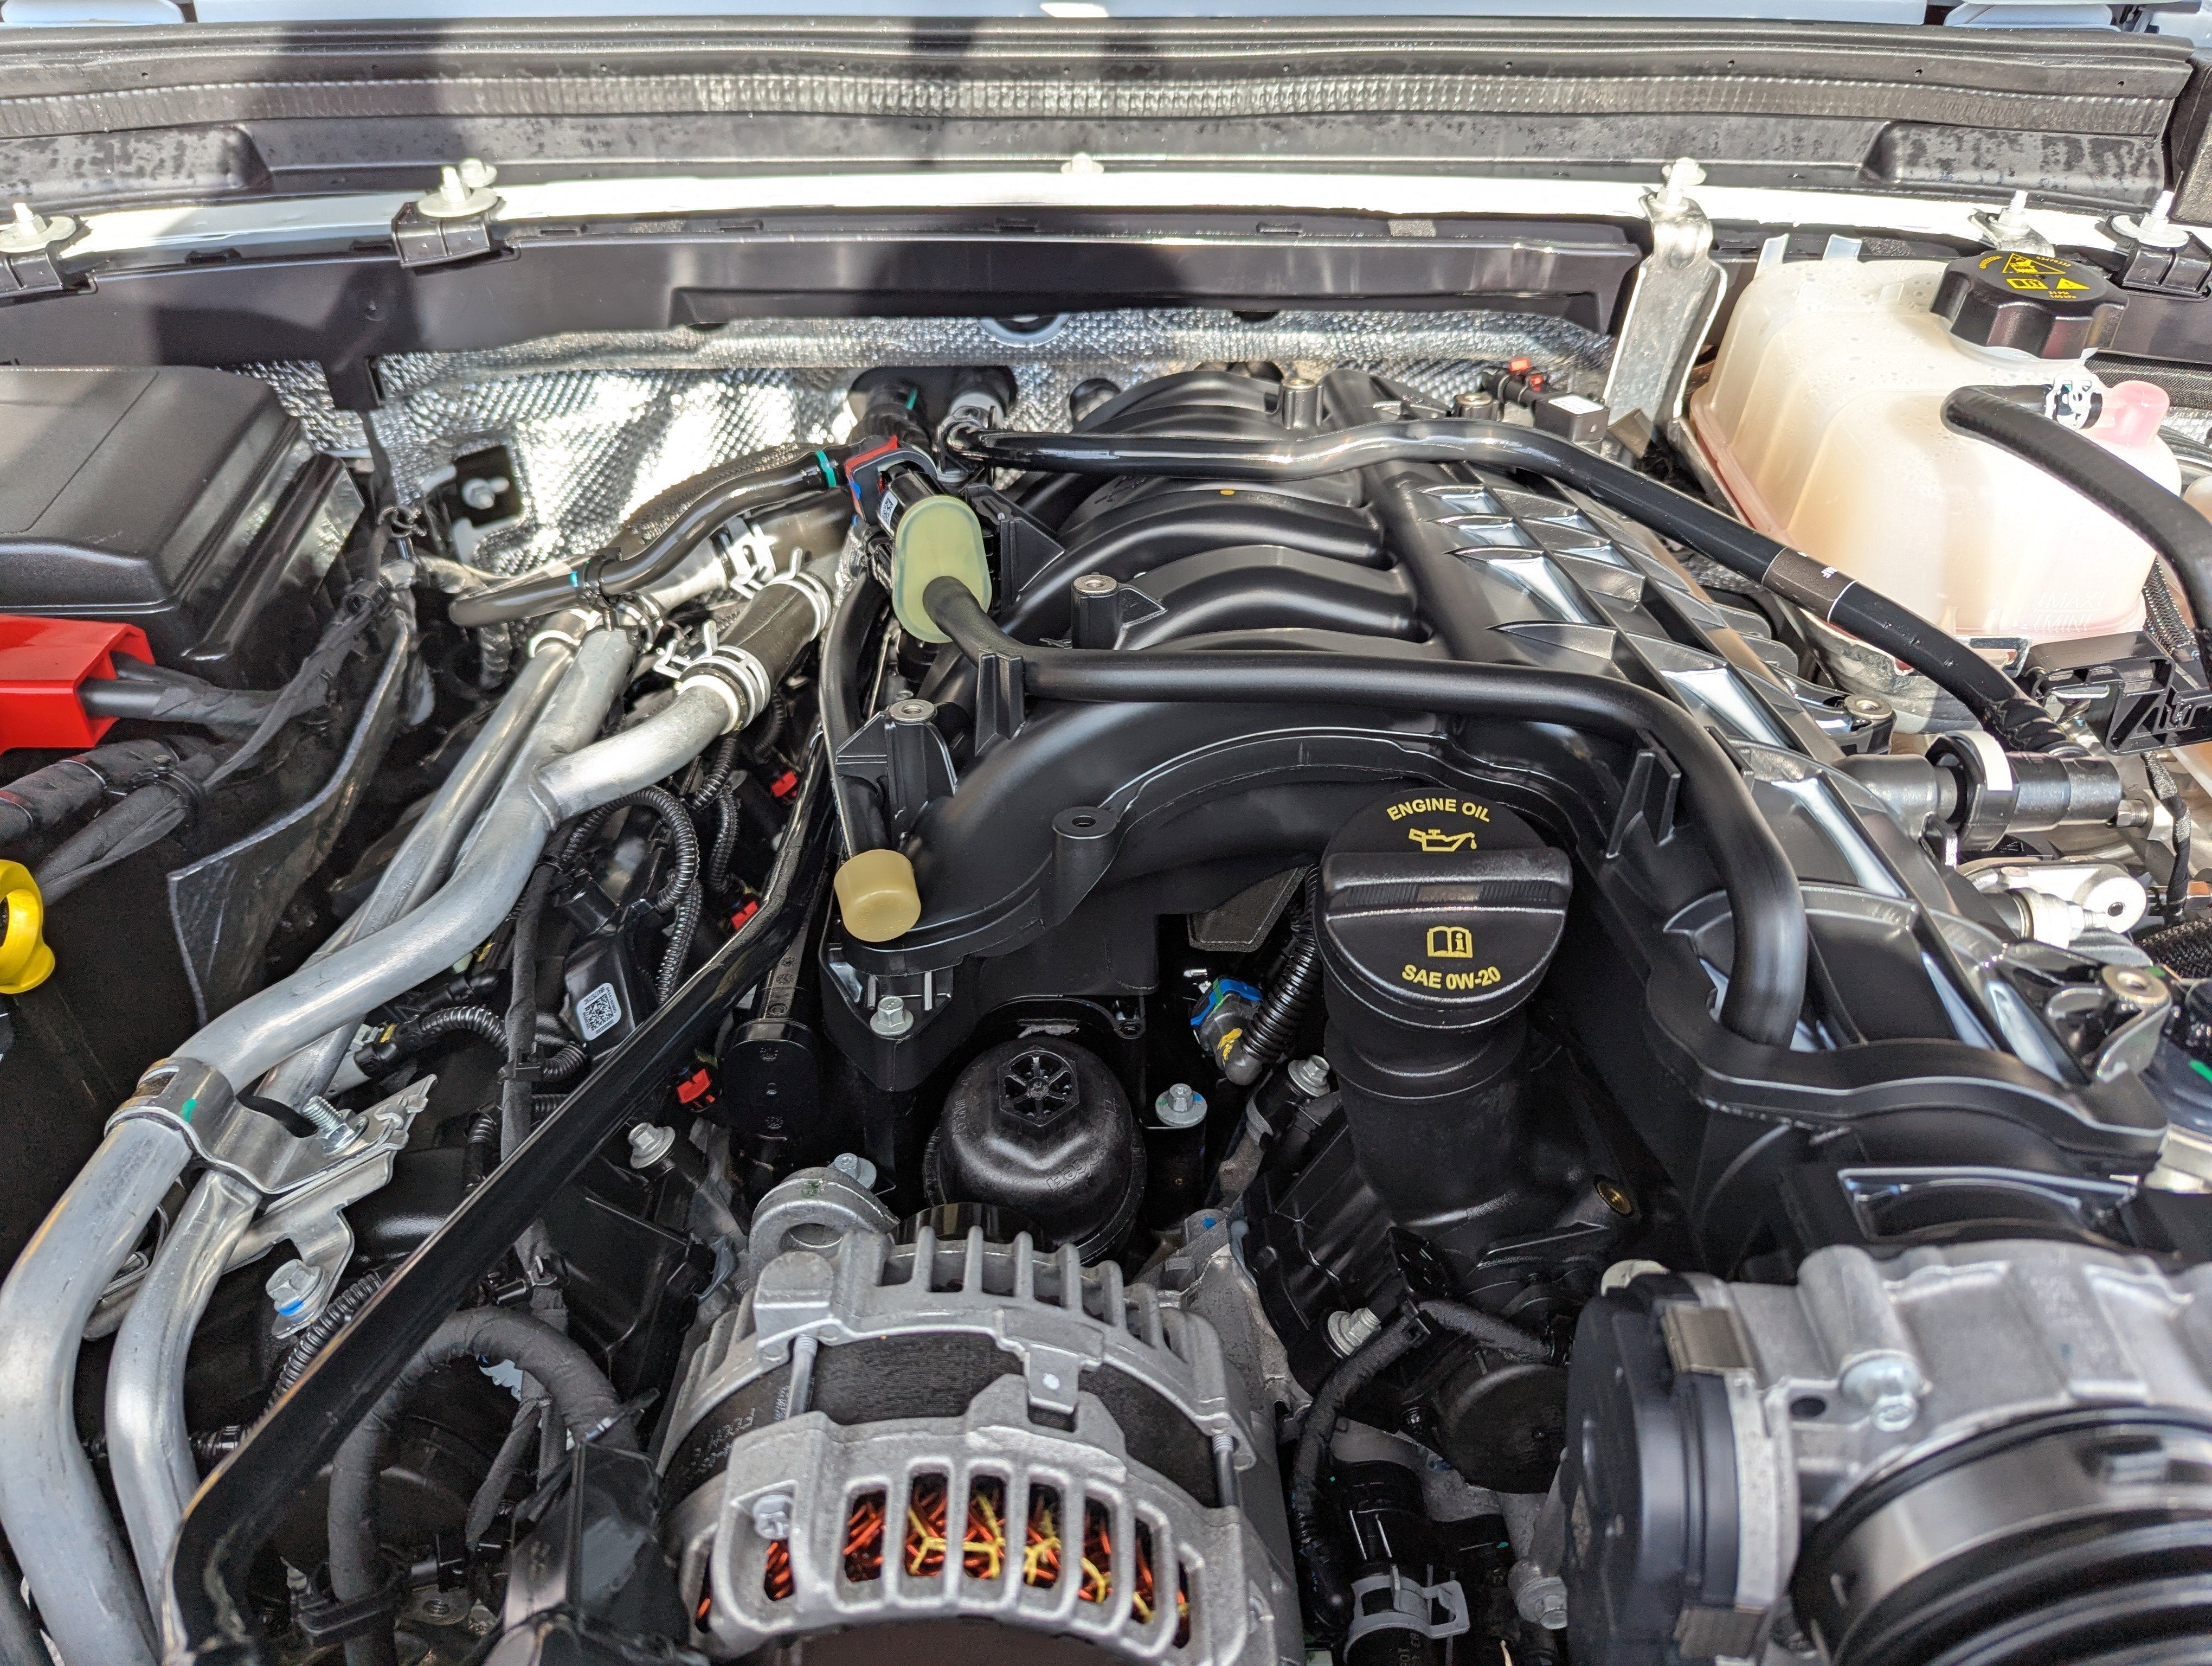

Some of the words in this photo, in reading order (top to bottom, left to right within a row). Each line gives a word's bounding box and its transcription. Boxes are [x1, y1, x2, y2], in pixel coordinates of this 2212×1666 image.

[1387, 799, 1456, 820] ENGINE
[1462, 802, 1489, 822] OIL
[1402, 964, 1441, 988] SAE
[1445, 966, 1501, 990] 0W-20
